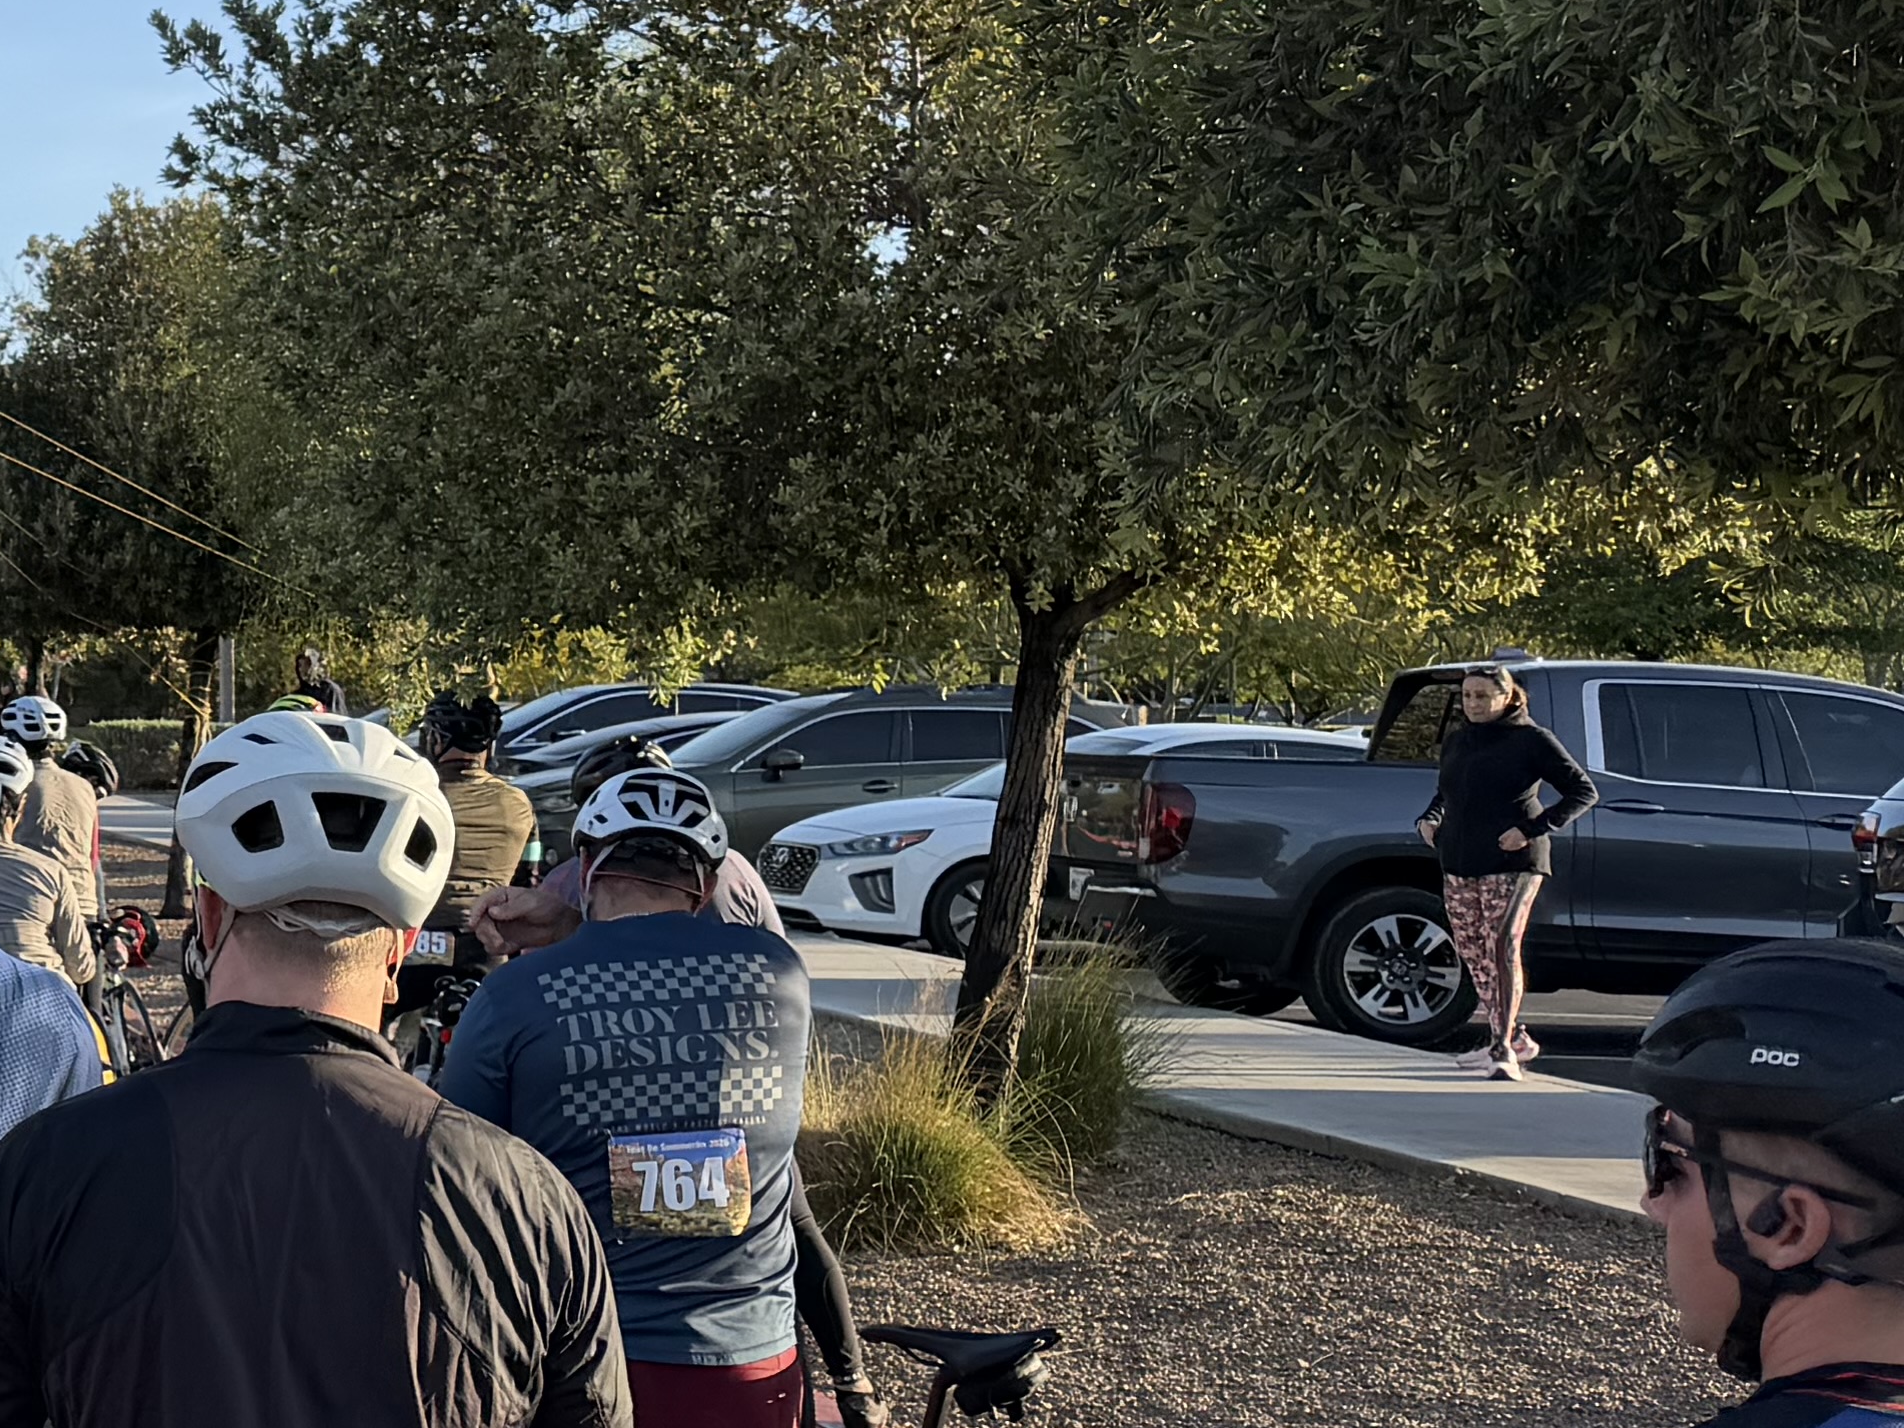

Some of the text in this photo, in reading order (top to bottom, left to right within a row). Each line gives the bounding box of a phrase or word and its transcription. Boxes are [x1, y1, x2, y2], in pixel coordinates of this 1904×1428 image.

[415, 930, 446, 956] 85
[557, 1000, 780, 1043] TROY LEE
[562, 1030, 780, 1075] DESIGNS.
[632, 1157, 730, 1212] 764
